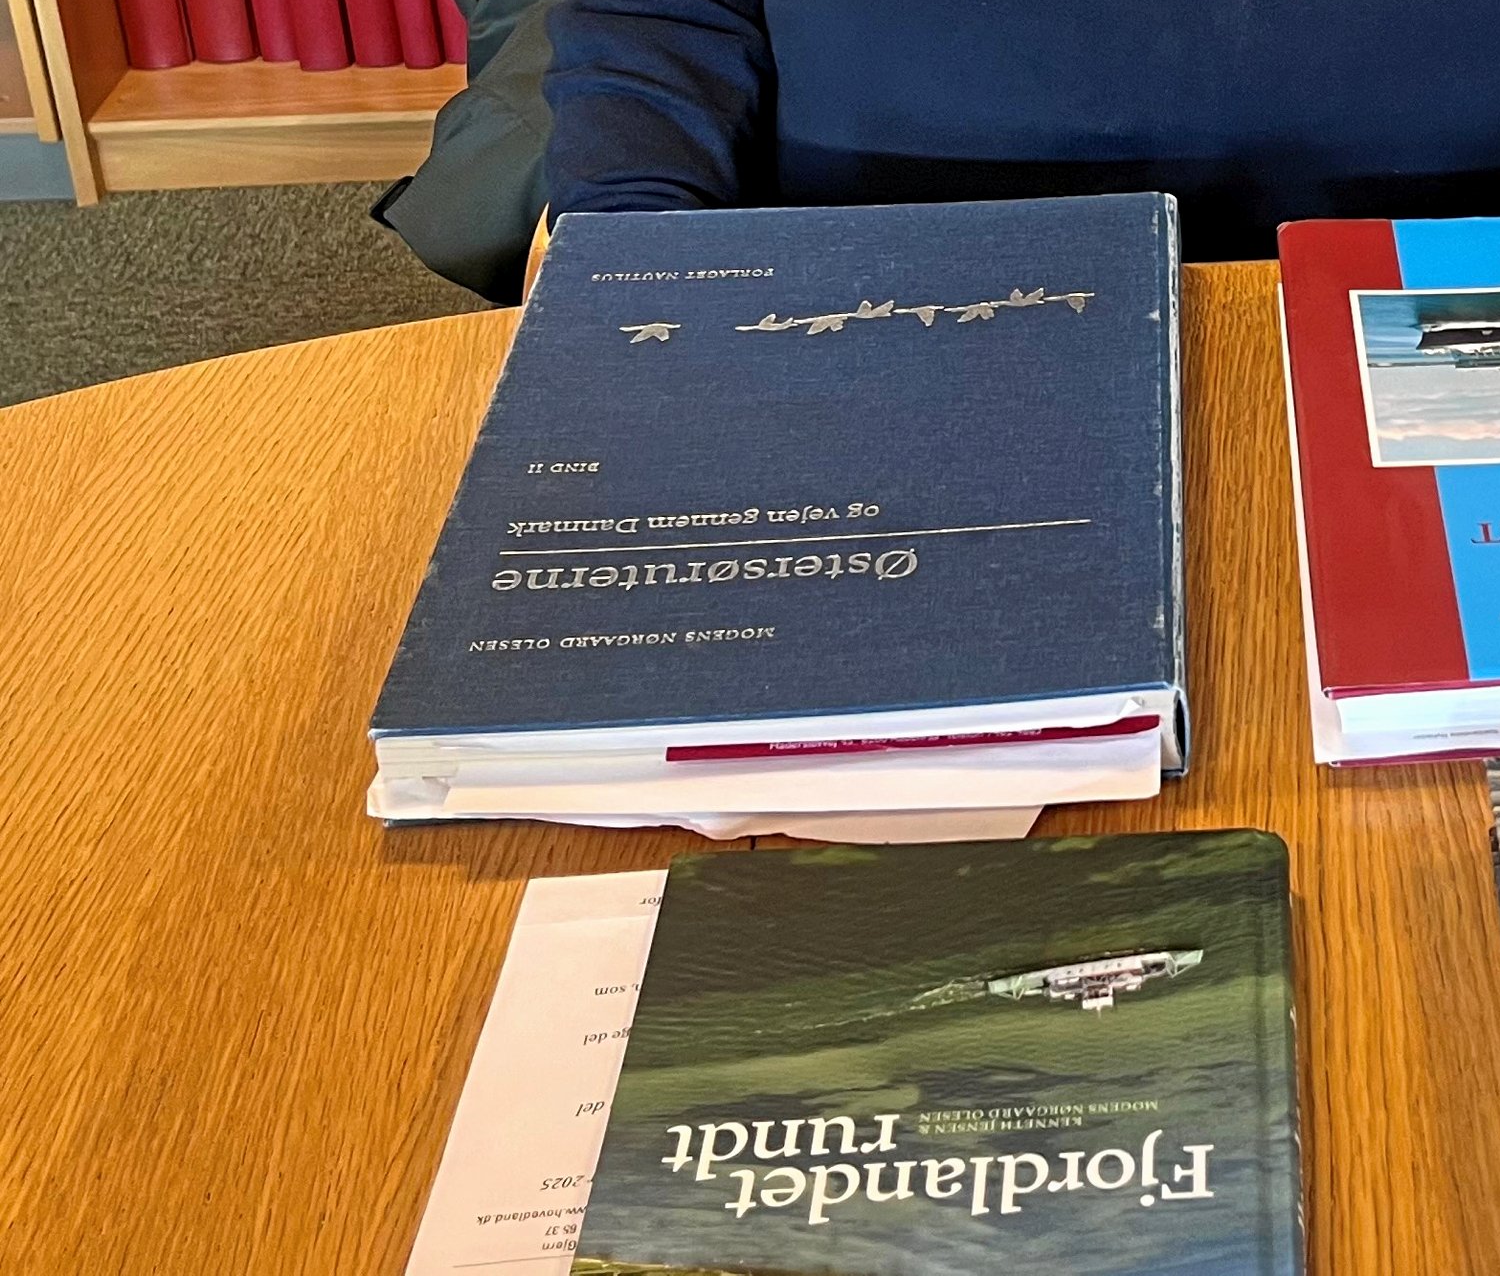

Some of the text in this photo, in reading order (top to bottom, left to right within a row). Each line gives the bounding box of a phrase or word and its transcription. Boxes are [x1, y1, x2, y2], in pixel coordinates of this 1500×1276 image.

[591, 267, 775, 282] FORLAGET NAUTILUS
[527, 461, 600, 474] BIND II
[506, 502, 881, 537] og vejen gennem Danmark
[491, 547, 918, 592] Østersøruterne
[469, 626, 776, 652] MOGENS NØRGAARD OLESEN
[594, 985, 627, 996] som
[583, 1032, 608, 1046] del
[575, 1100, 605, 1118] del
[918, 1100, 1159, 1122] MOGENS NØRGAARD OLESEN
[918, 1116, 1082, 1135] KENNETH JENSEN &
[660, 1113, 900, 1182] rundt
[540, 1174, 584, 1191] 2025
[725, 1128, 1215, 1226] Fjordlandet
[545, 1226, 558, 1237] 37
[541, 1238, 577, 1252] Gjern
